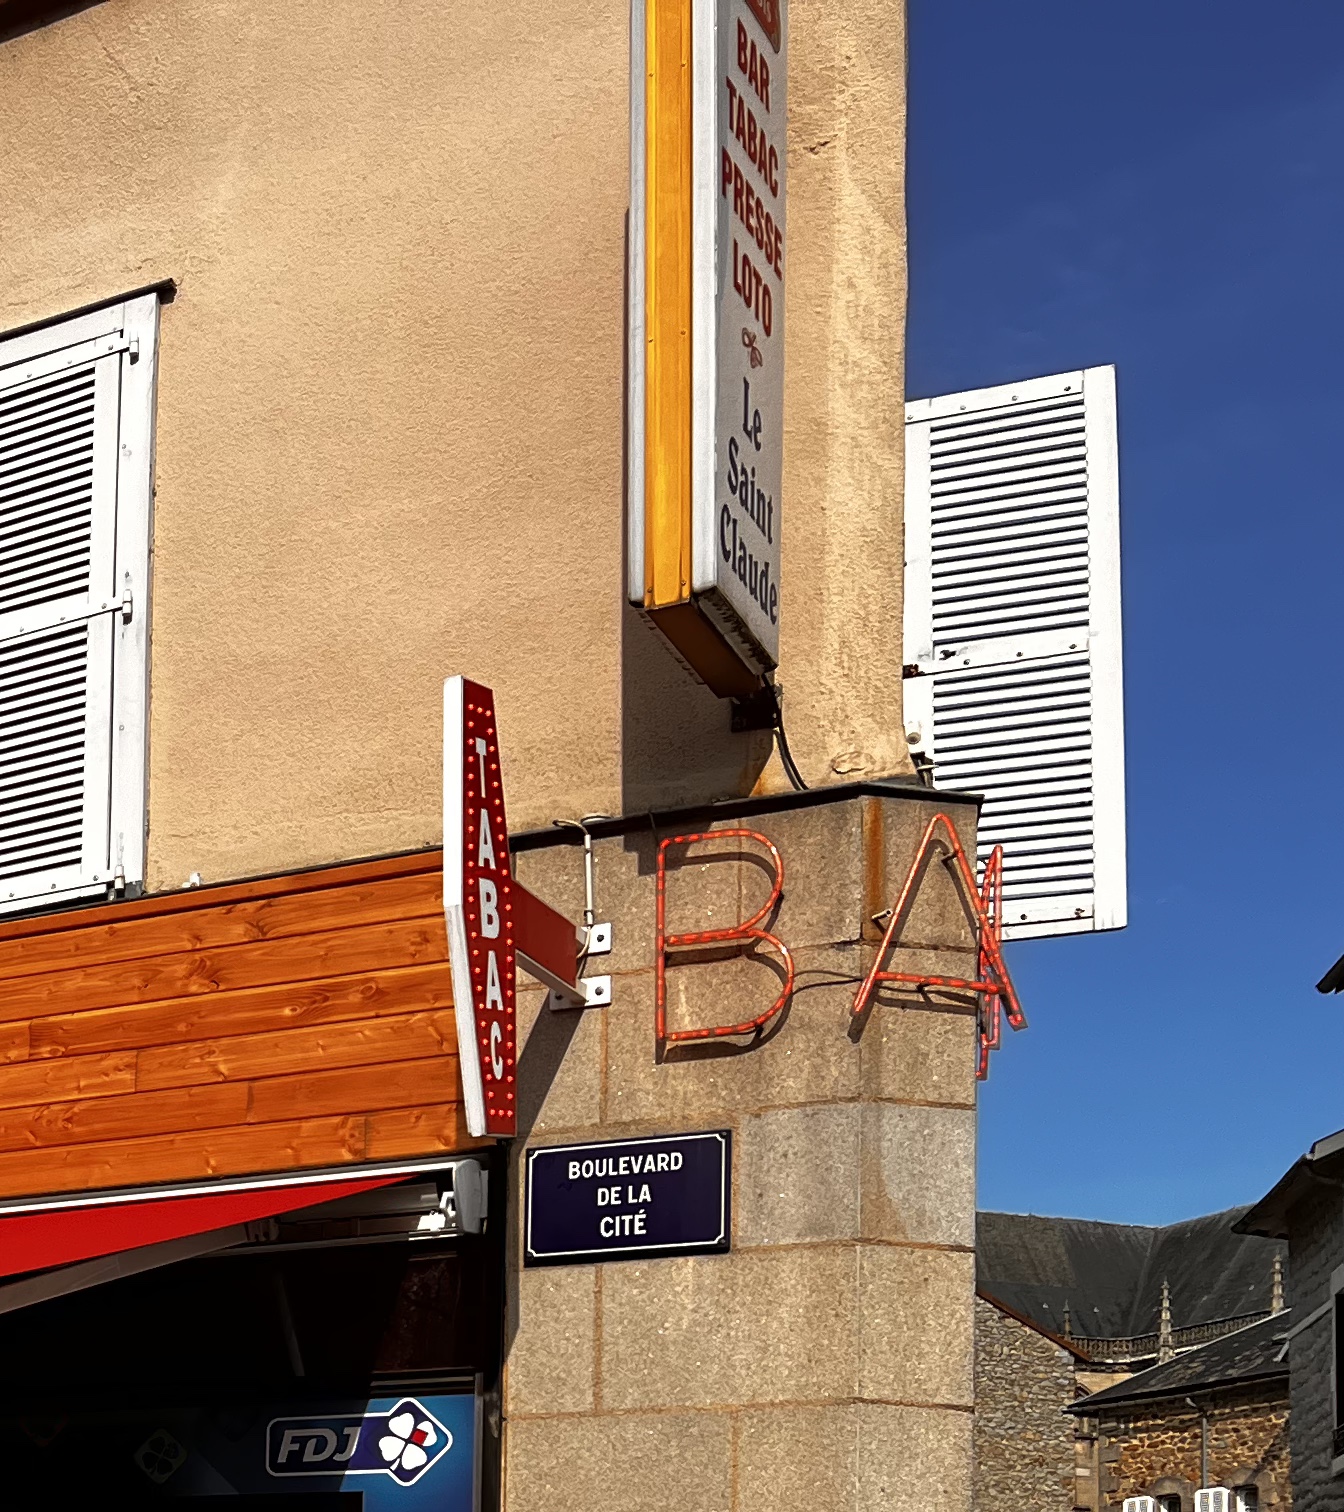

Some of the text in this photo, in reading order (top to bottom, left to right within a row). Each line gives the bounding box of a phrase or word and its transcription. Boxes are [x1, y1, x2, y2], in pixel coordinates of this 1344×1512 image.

[737, 17, 770, 113] BAR
[726, 75, 778, 198] TABAC
[722, 145, 782, 281] PRESSE
[733, 237, 772, 337] LOTO
[742, 376, 762, 451] Le
[728, 436, 773, 545] Saint
[720, 503, 777, 625] Claude
[474, 736, 503, 1082] TABAC
[568, 1152, 683, 1180] BOULEVARD
[597, 1184, 652, 1206] DE LA
[600, 1209, 647, 1238] CITÉ
[276, 1426, 362, 1464] FDJ
